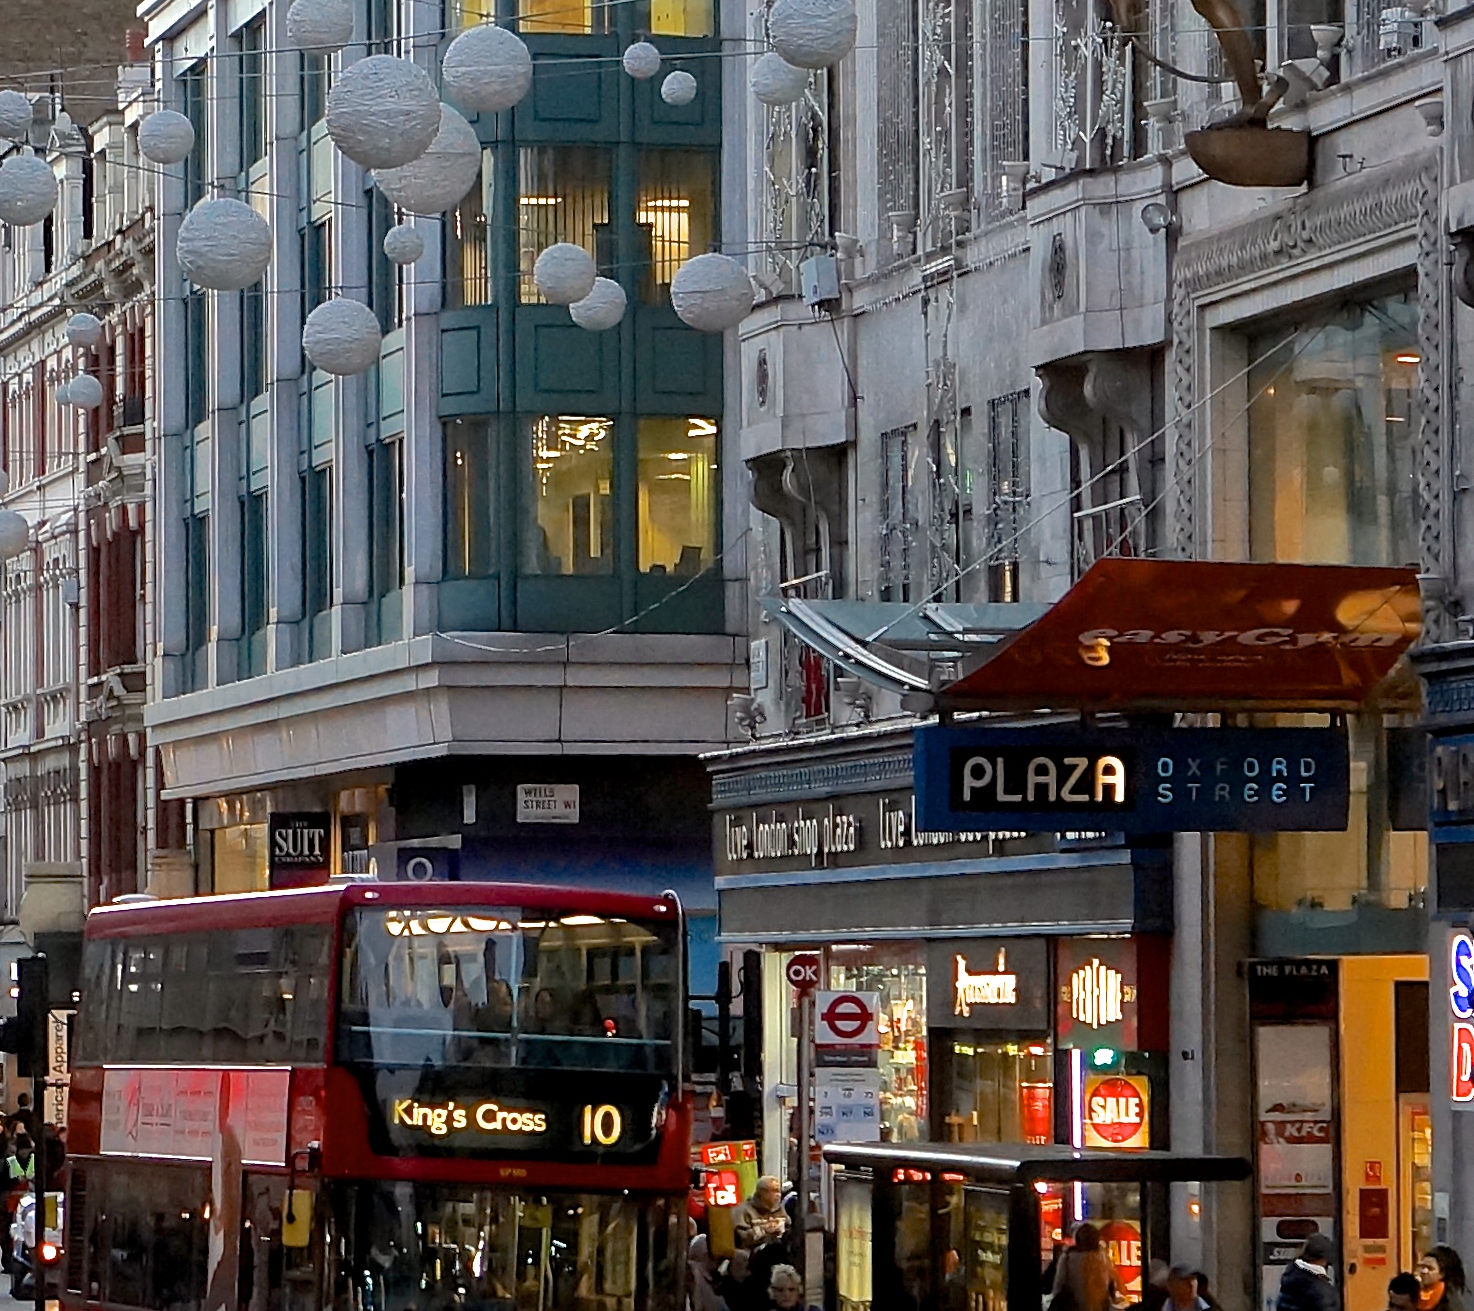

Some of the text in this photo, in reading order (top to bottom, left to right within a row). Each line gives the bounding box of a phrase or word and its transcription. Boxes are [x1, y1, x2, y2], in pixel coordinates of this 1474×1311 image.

[963, 755, 1125, 803] PLAZA
[1157, 757, 1316, 778] OXFORD
[523, 799, 558, 811] STREET
[1157, 783, 1315, 804] STREET
[274, 828, 325, 857] SUIT
[725, 813, 749, 861] live
[822, 803, 855, 868] plaza
[406, 856, 440, 882] O
[788, 964, 818, 982] OK
[1256, 963, 1329, 977] THE PLAZA
[1091, 1096, 1141, 1124] SALE
[392, 1098, 622, 1146] King's Cross 10
[1284, 1122, 1328, 1137] KFC
